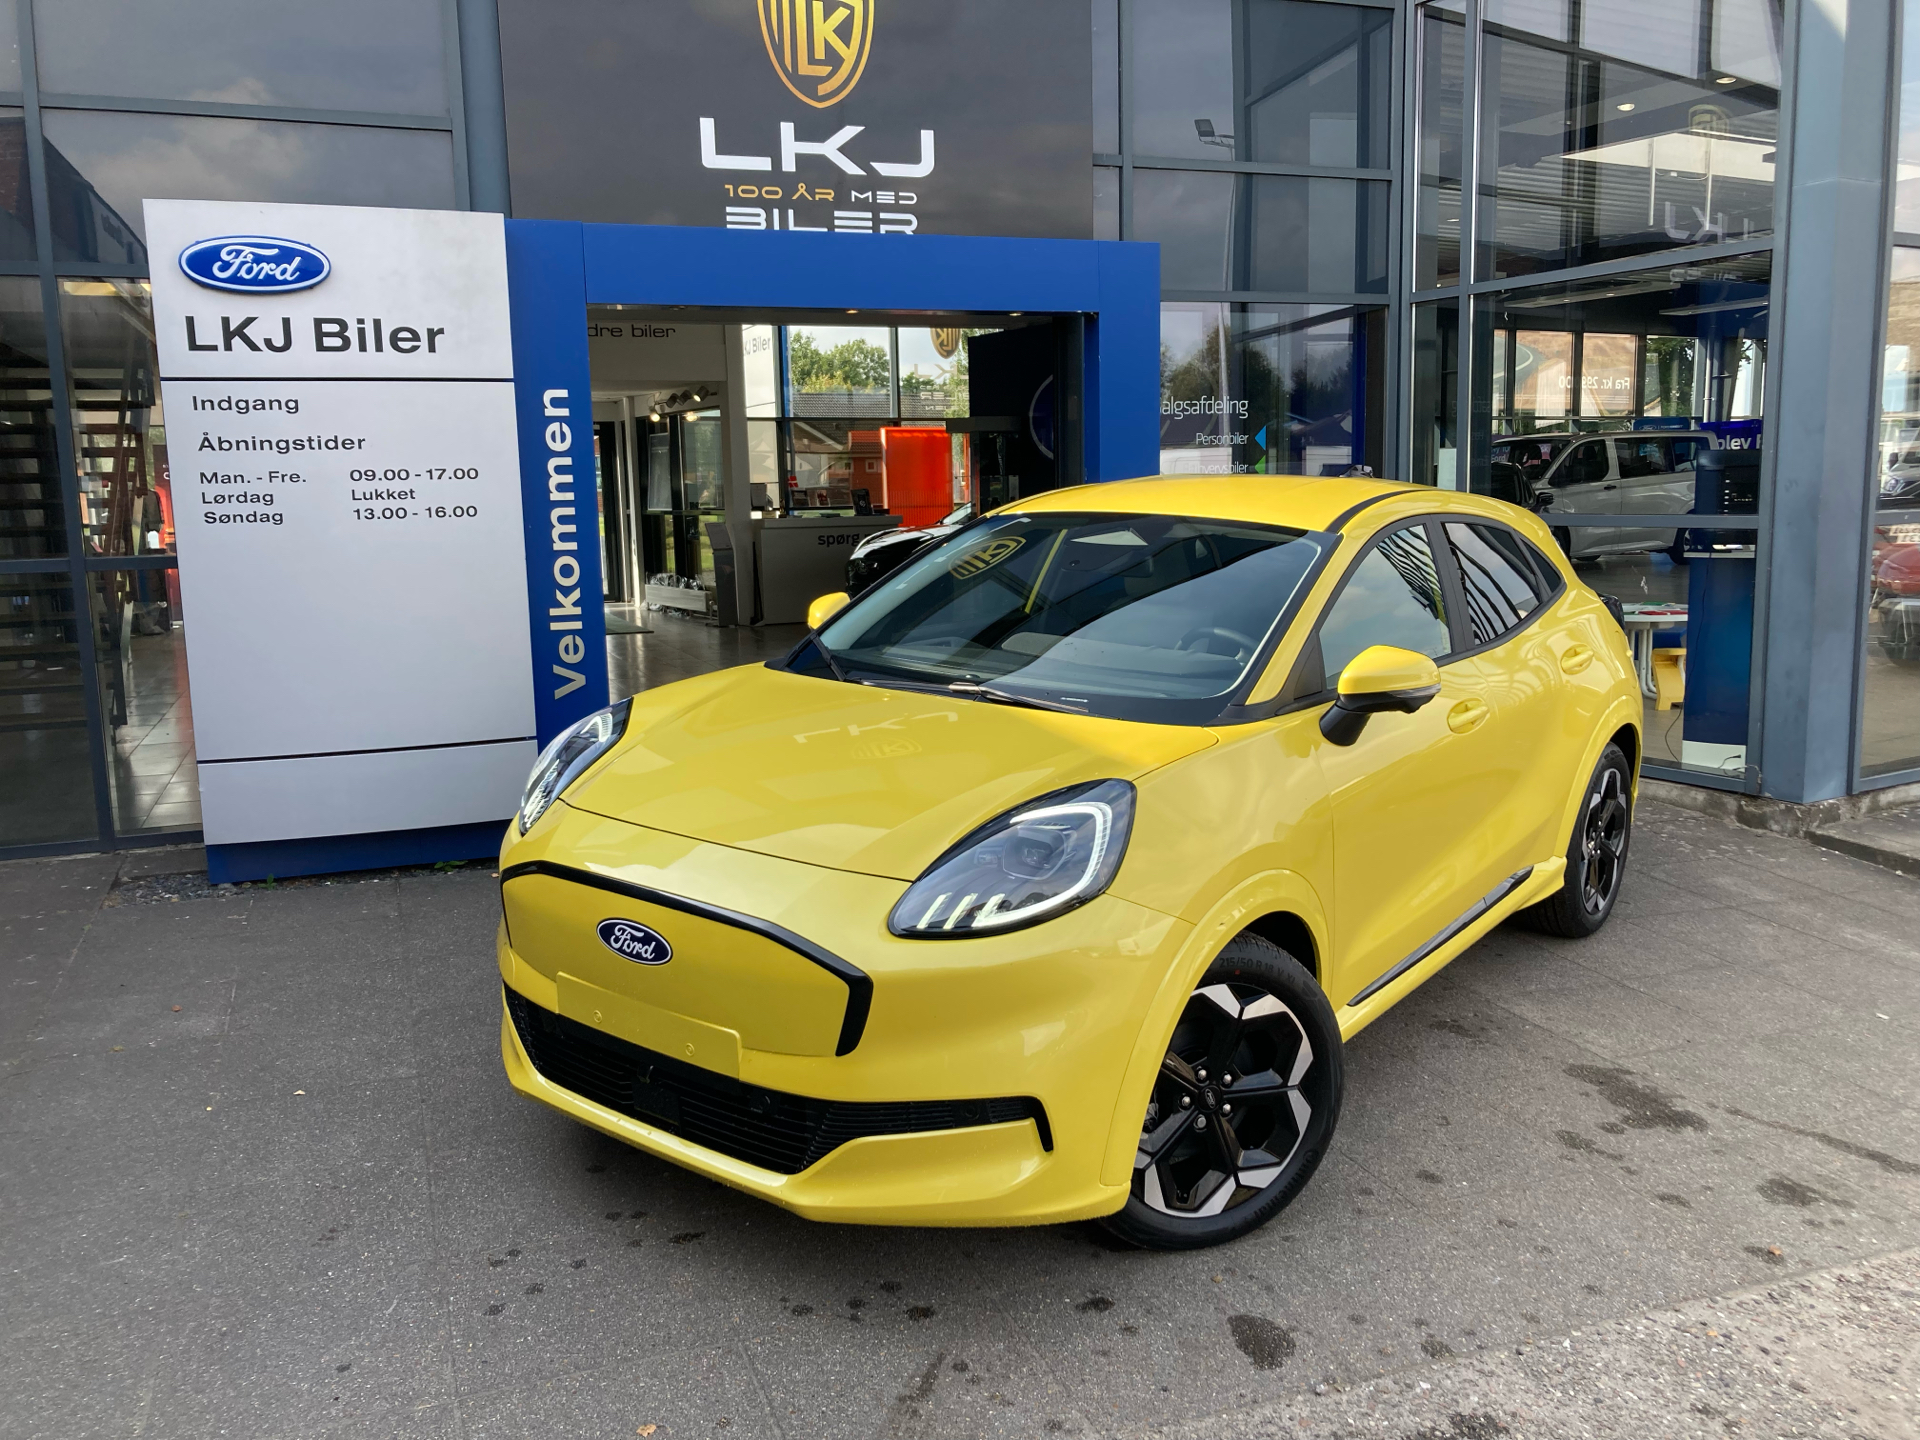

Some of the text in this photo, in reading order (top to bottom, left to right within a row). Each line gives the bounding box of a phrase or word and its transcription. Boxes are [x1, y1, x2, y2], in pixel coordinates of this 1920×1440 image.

[699, 117, 935, 177] LKJ
[725, 182, 917, 205] 100 ÅR MED
[725, 206, 918, 235] BILER
[212, 245, 302, 281] Ford
[185, 315, 446, 354] LKJ Biler
[631, 324, 676, 338] biler
[752, 335, 771, 353] Biler
[192, 395, 299, 414] Indgang
[1160, 395, 1249, 419] algsafdeling
[198, 431, 366, 455] Åbningstider
[1196, 432, 1249, 445] Personbiler
[199, 471, 251, 484] Man.
[268, 470, 307, 484] Fre.
[349, 468, 410, 482] 09.00
[425, 467, 479, 481] 17.00
[201, 488, 416, 506] Lørdag Lukket
[203, 511, 284, 526] Søndag
[352, 507, 408, 521] 13.00
[424, 505, 478, 519] 16.00
[543, 388, 587, 700] Velkommen
[817, 532, 860, 548] spørg
[610, 924, 656, 960] Ford
[1219, 957, 1254, 969] 215/50
